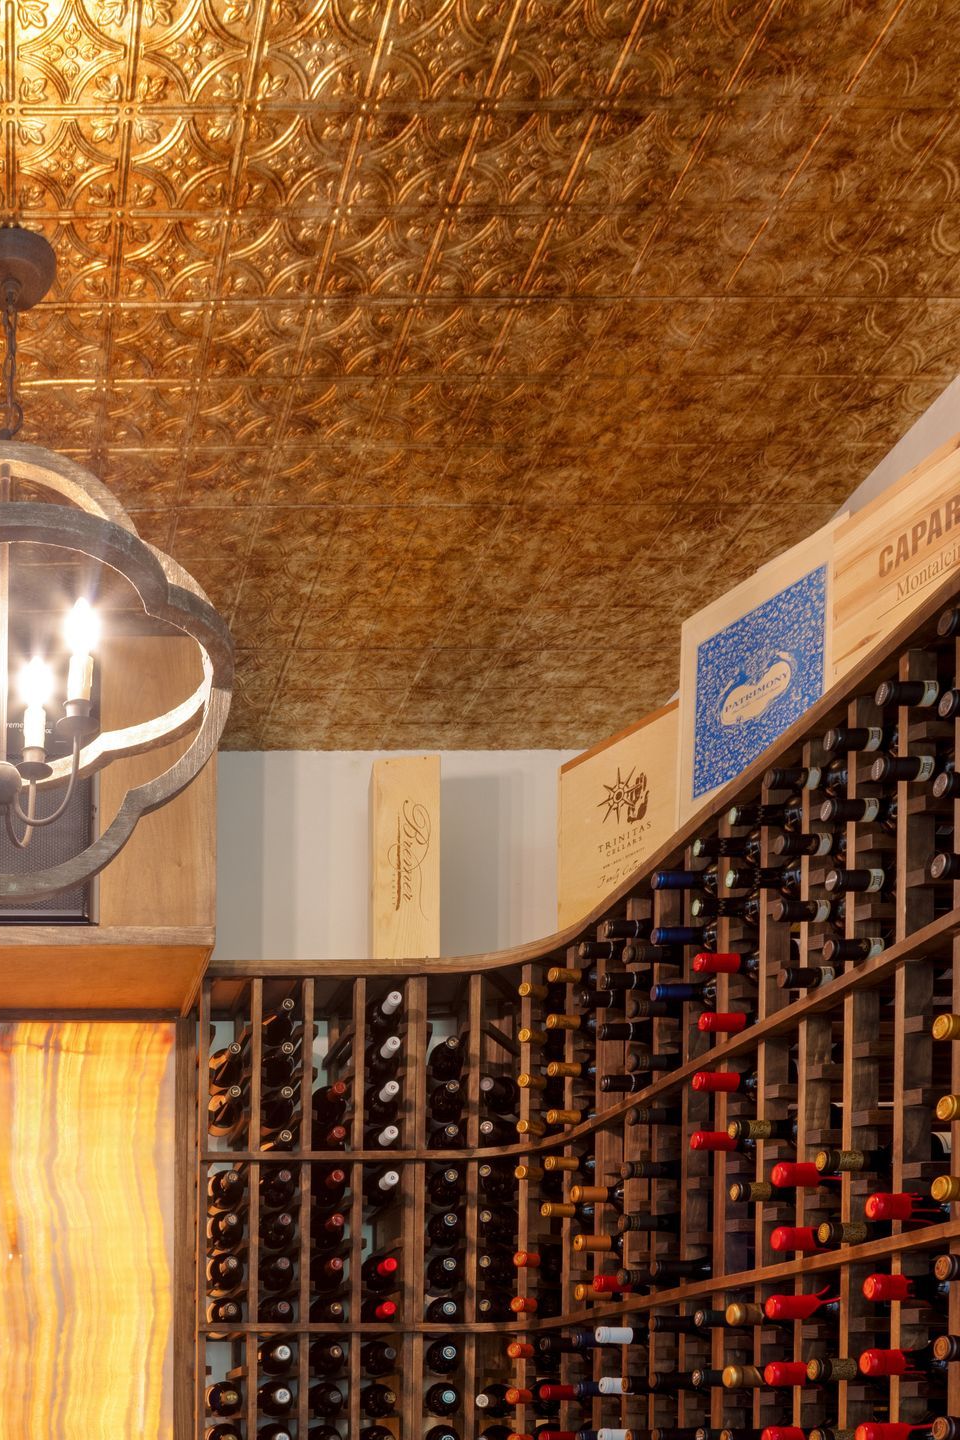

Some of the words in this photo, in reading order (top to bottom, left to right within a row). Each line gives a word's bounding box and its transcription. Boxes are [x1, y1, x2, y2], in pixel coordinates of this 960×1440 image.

[725, 672, 787, 713] PATRIMONY
[598, 820, 653, 853] TRINITAS
[606, 836, 643, 857] CELLARS
